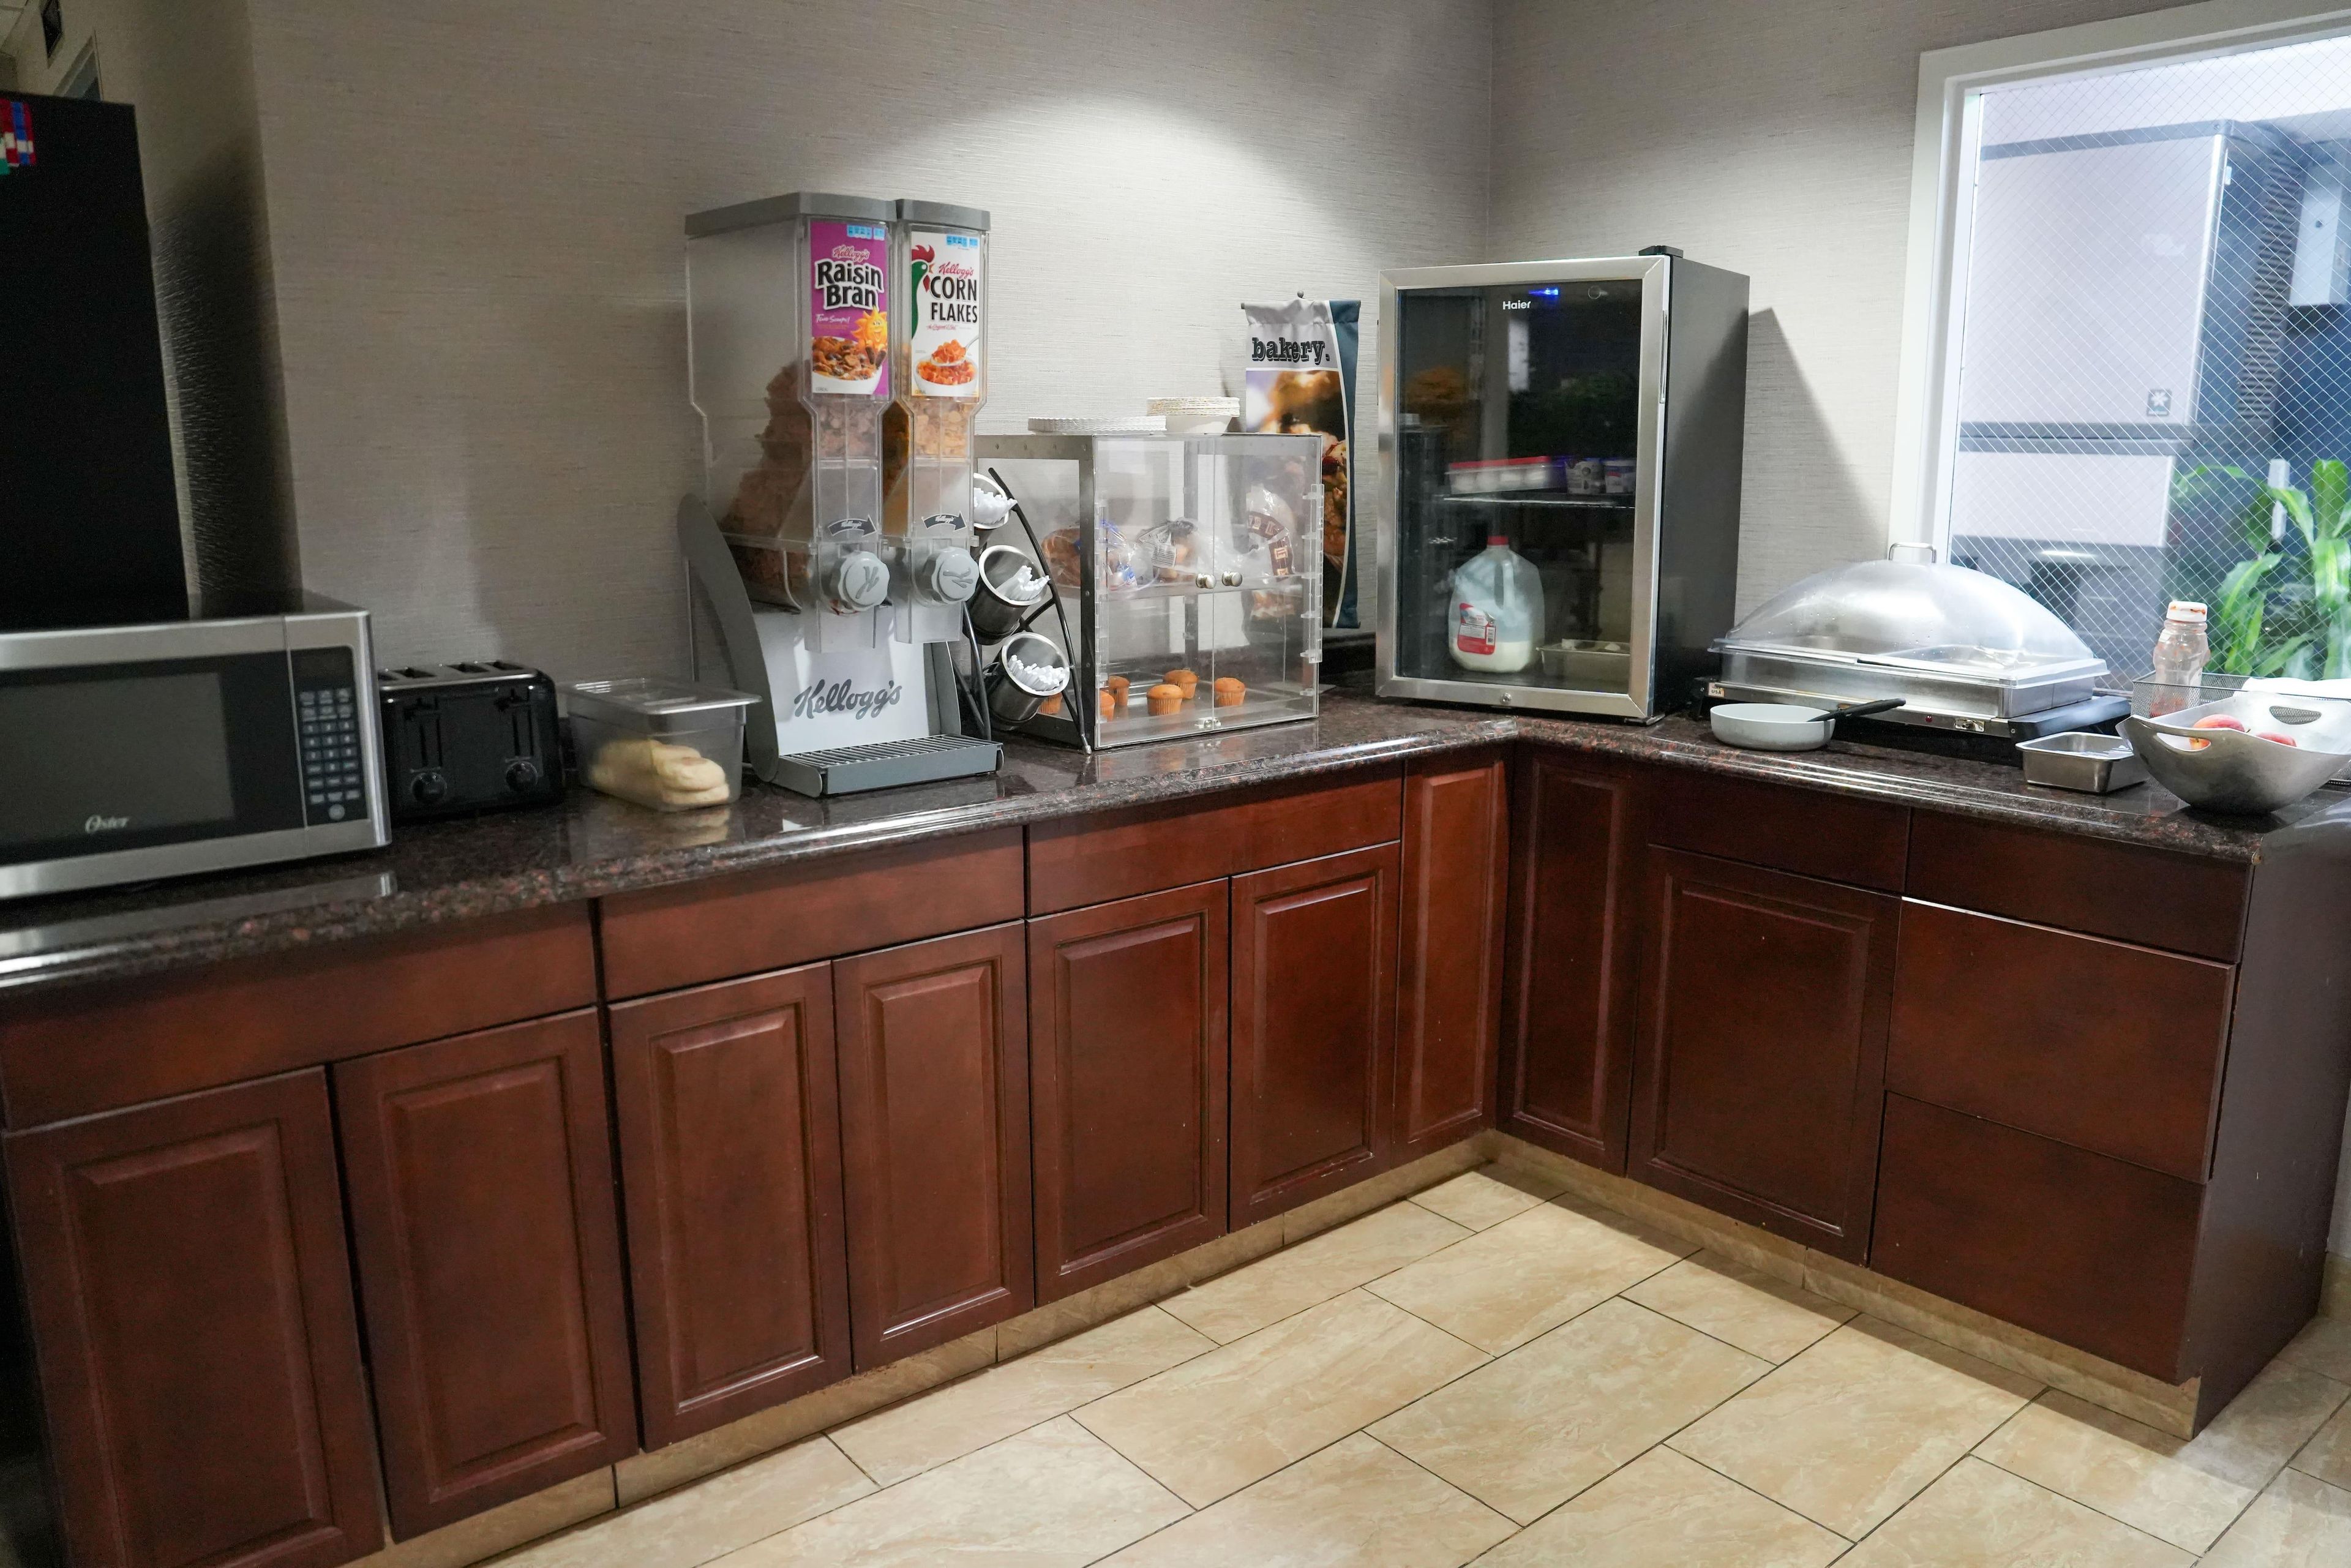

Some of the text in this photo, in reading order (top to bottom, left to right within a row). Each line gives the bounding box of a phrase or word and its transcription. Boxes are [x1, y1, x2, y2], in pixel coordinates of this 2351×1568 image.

[833, 244, 870, 263] Kellogg's
[817, 261, 882, 290] Raisin
[939, 261, 973, 279] Kellogg's
[826, 284, 877, 307] Bran
[930, 276, 977, 301] CORN
[931, 302, 978, 323] FLAKES
[1502, 300, 1531, 310] Haier
[794, 679, 902, 721] Kellogg's
